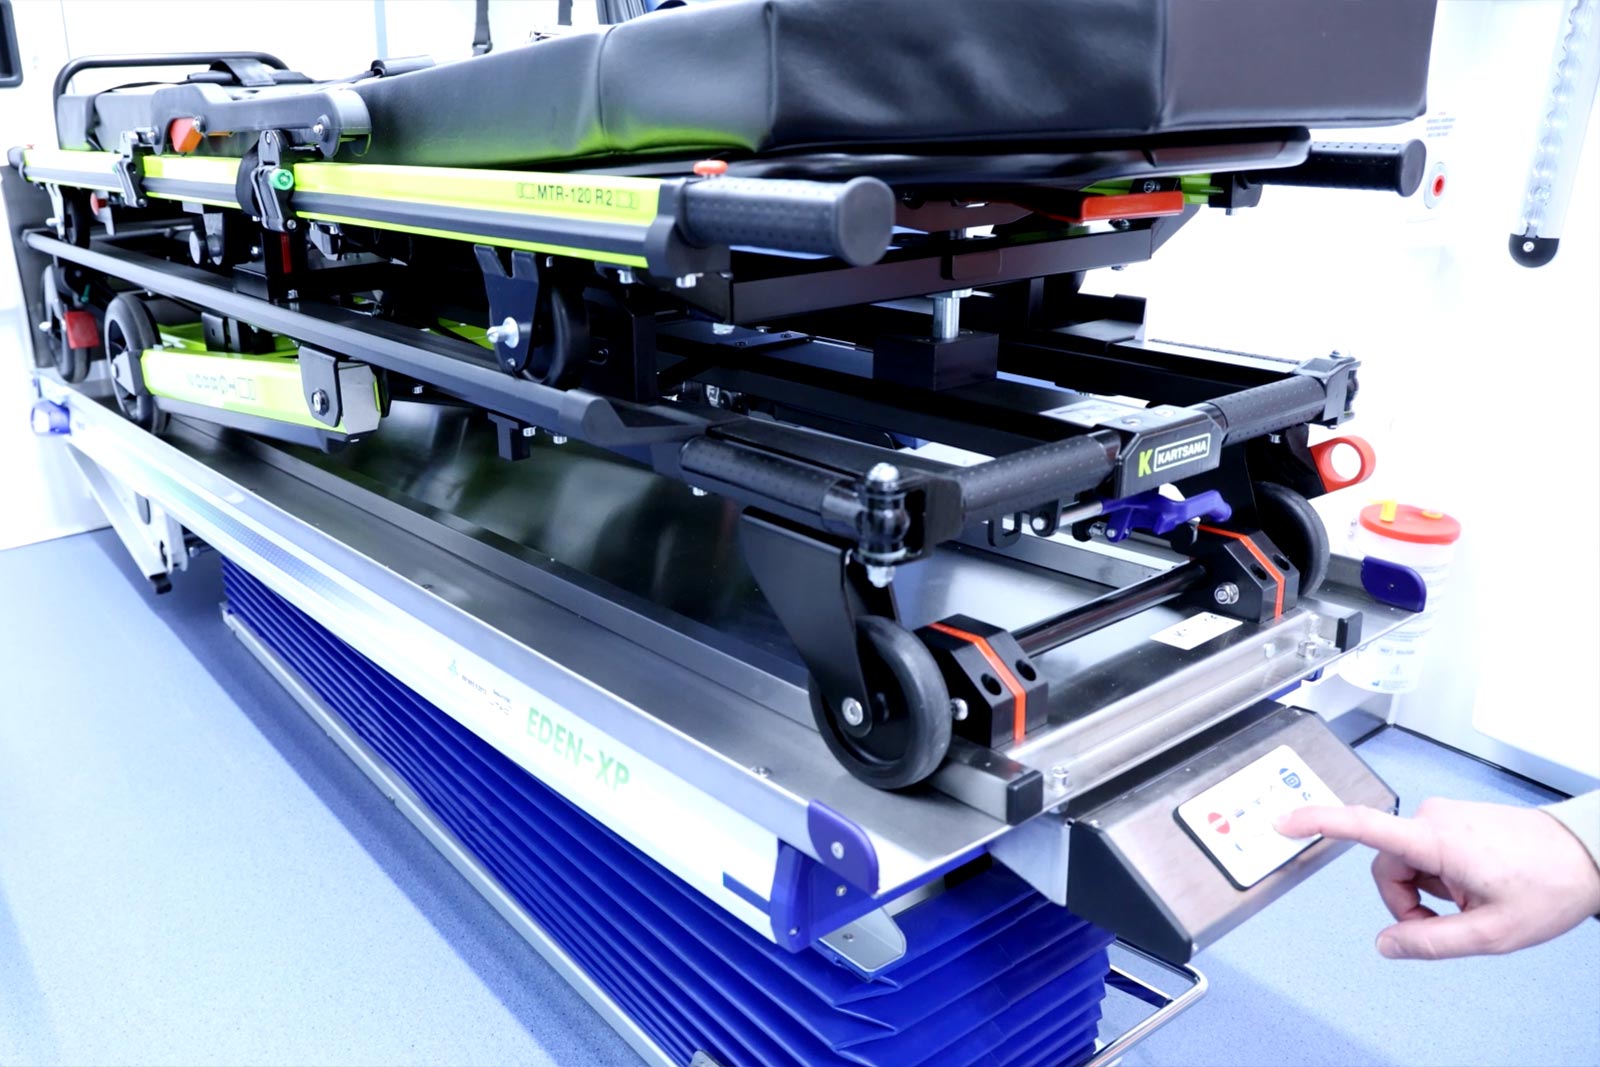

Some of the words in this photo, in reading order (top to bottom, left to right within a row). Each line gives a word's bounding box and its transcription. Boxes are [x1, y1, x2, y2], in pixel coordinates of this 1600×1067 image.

[537, 184, 592, 203] MTR-120
[595, 188, 613, 207] R2
[1138, 448, 1153, 478] K
[1157, 440, 1207, 465] KARTSANA
[526, 706, 631, 791] EDEN-XP
